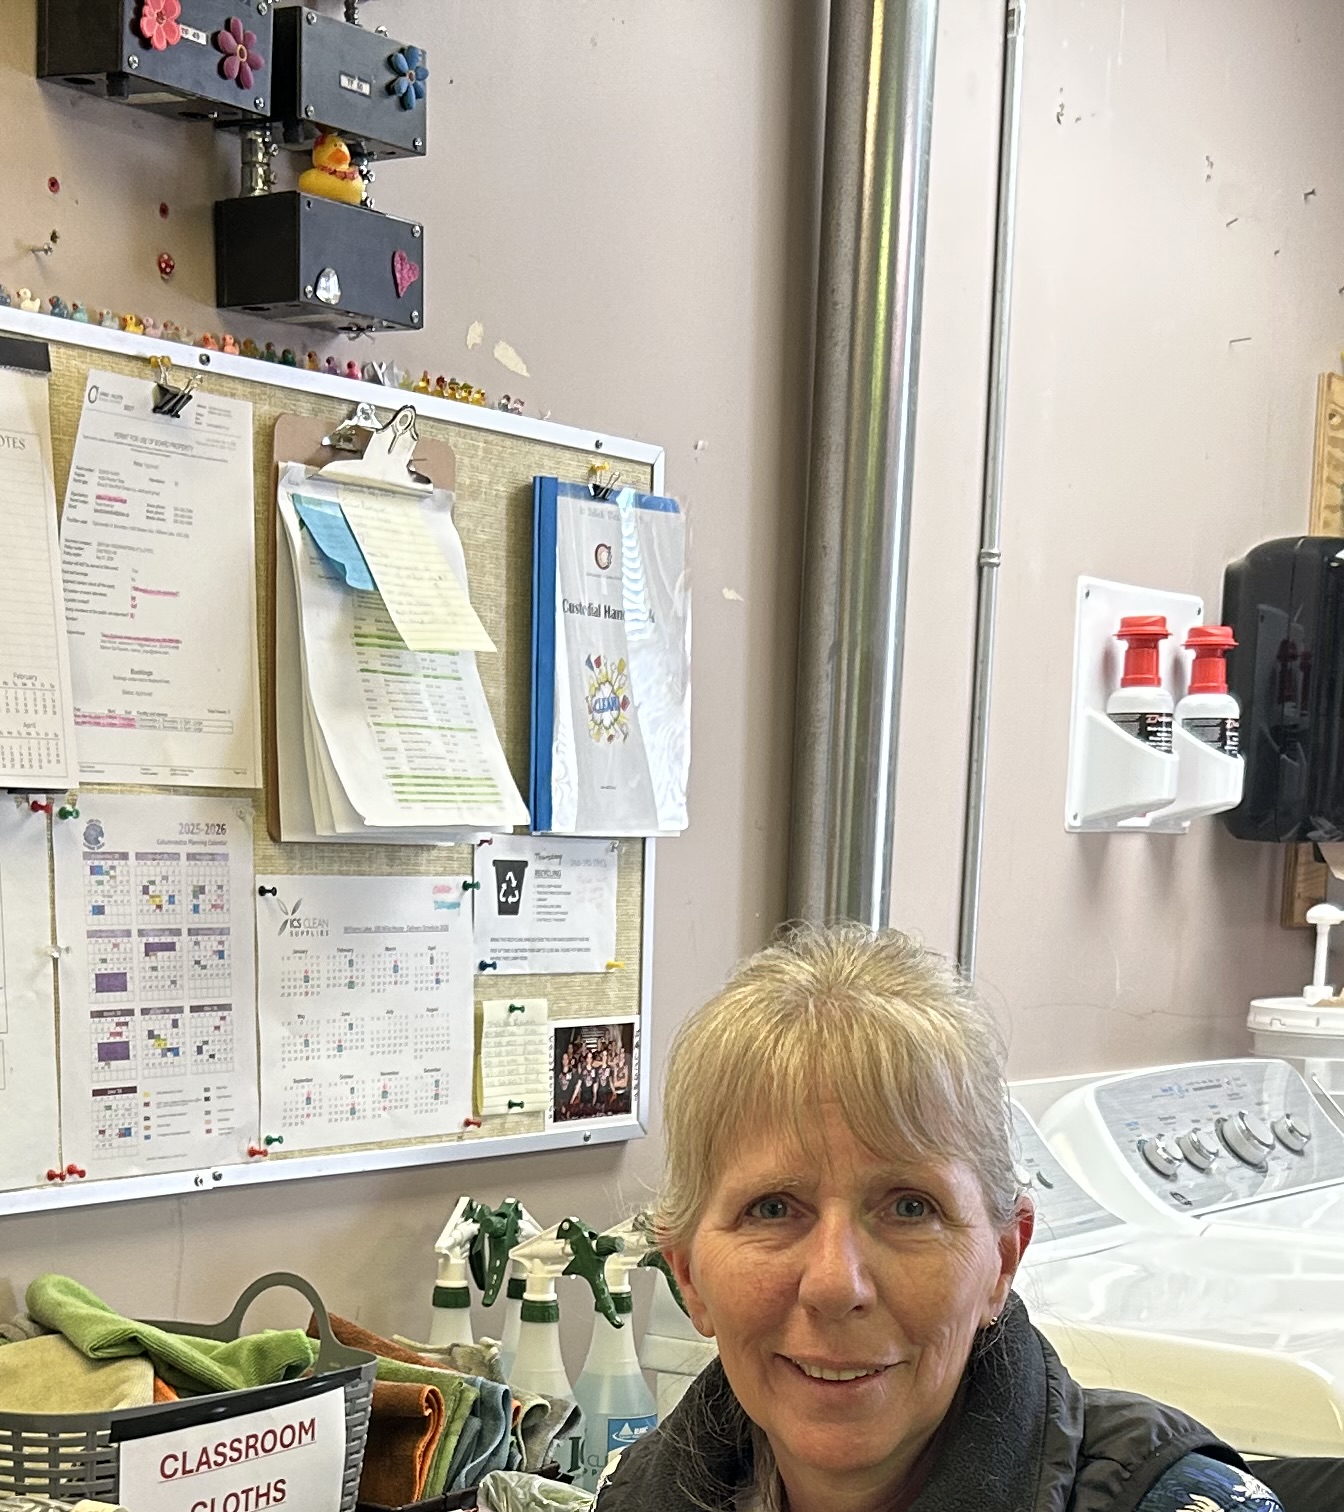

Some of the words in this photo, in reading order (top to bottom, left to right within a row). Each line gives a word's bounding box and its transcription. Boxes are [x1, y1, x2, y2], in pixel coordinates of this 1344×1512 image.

[179, 823, 226, 835] 2025-2026
[289, 918, 301, 929] ICS
[303, 918, 329, 929] CLEAN
[160, 1417, 317, 1479] CLASSROOM
